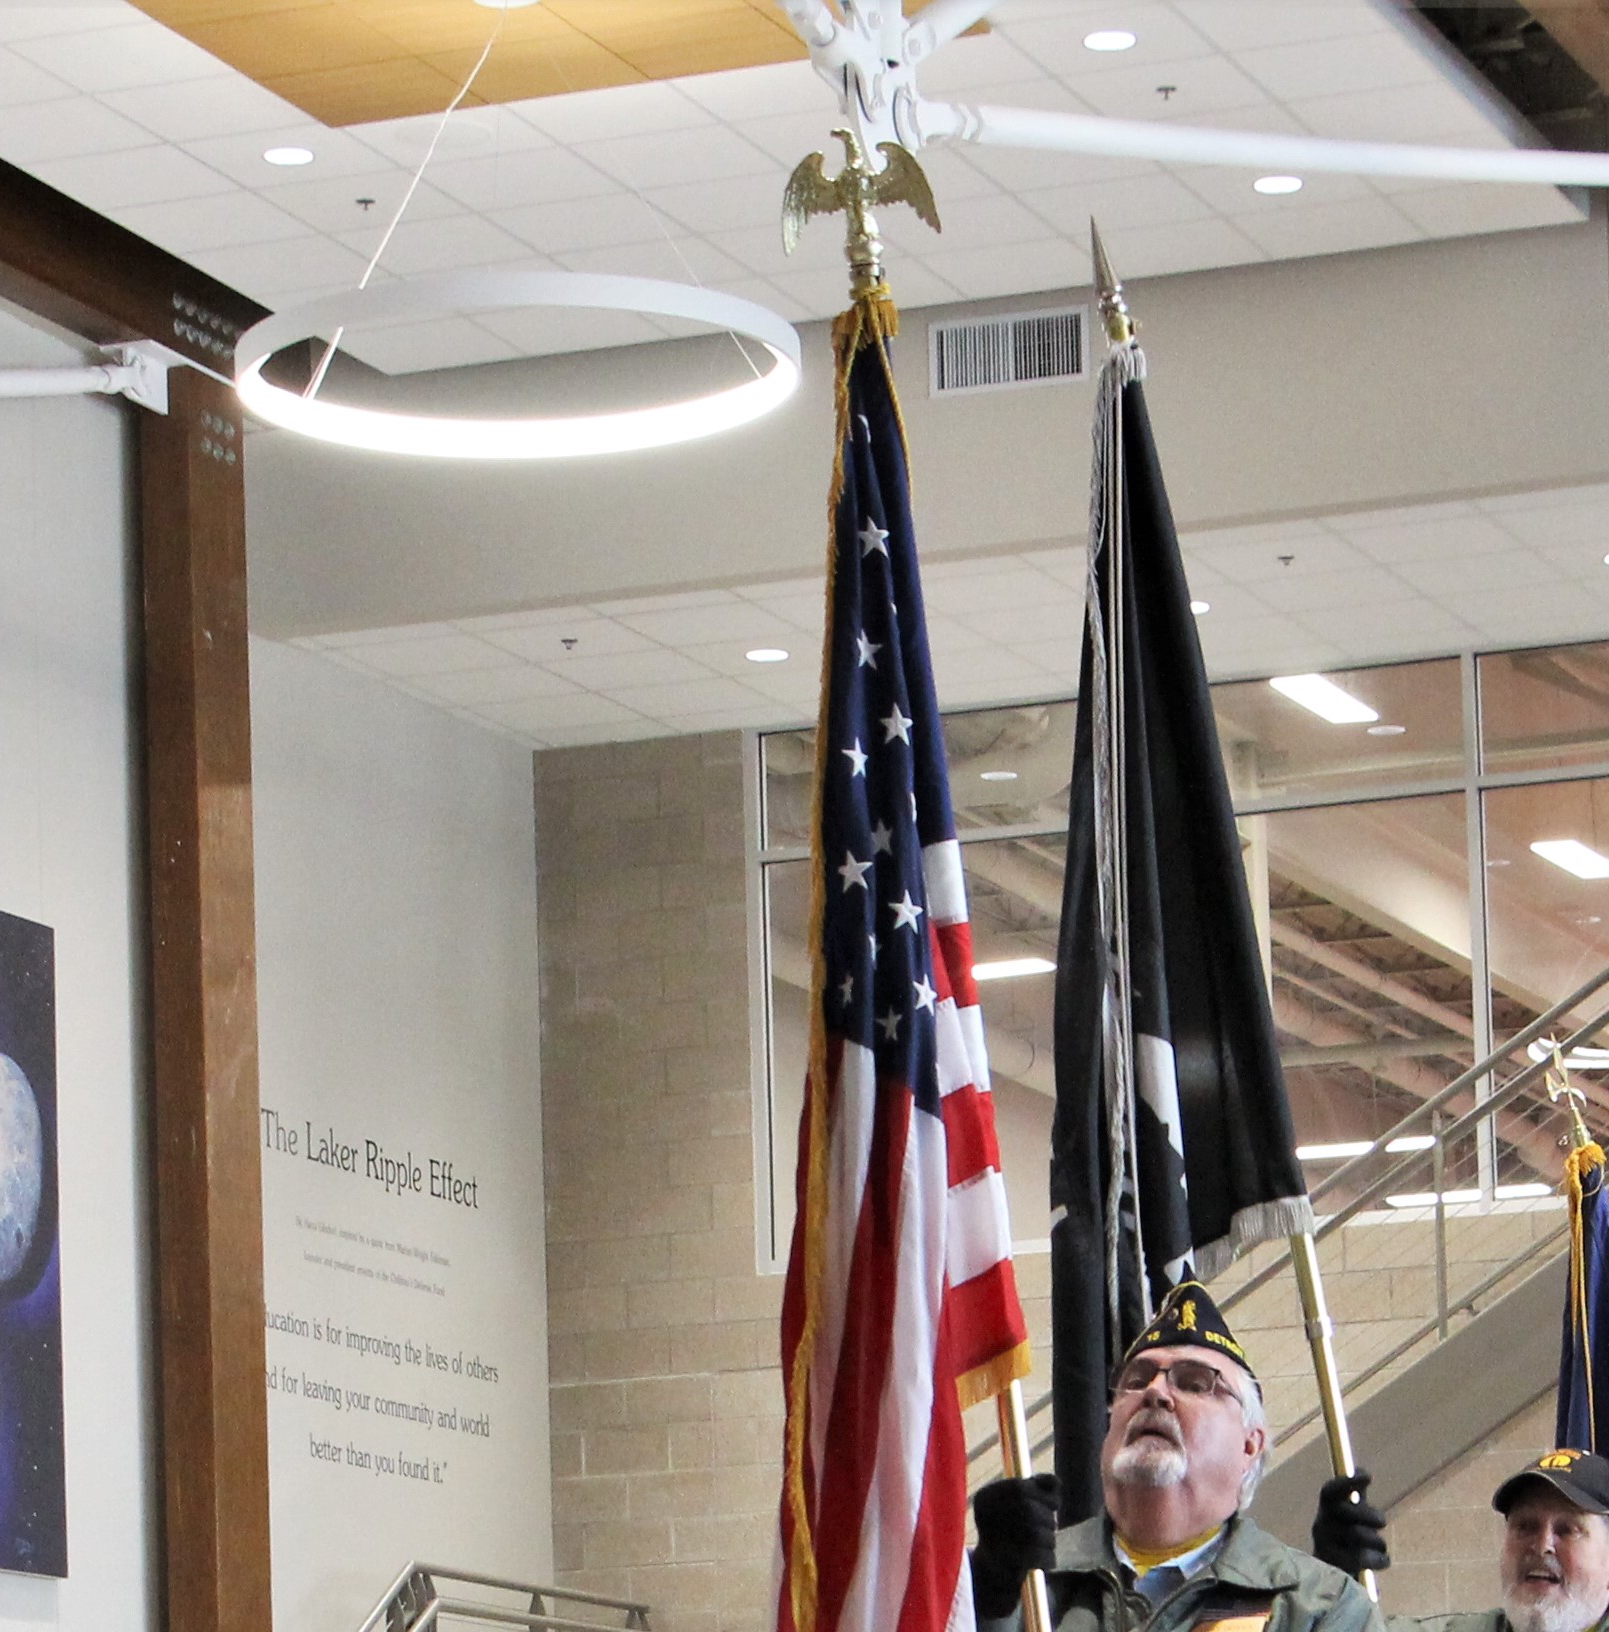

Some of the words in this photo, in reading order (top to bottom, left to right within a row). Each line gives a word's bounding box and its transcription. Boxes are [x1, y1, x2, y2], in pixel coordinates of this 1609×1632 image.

[261, 1108, 298, 1156] The
[305, 1121, 358, 1173] Laker
[365, 1139, 423, 1196] Ripple
[429, 1158, 479, 1209] Effect
[264, 1311, 309, 1338] ucation
[313, 1317, 322, 1340] is
[326, 1318, 342, 1345] for
[346, 1326, 401, 1366] improving
[404, 1339, 421, 1366] the
[425, 1343, 448, 1372] lives
[452, 1351, 462, 1374] of
[466, 1355, 499, 1383] others
[282, 1366, 298, 1394] for
[302, 1372, 342, 1410] leaving
[345, 1389, 370, 1412] your
[374, 1396, 434, 1430] community
[438, 1407, 457, 1430] and
[461, 1414, 490, 1437] world
[309, 1432, 342, 1463] better
[346, 1441, 371, 1470] than
[375, 1453, 394, 1477] you
[398, 1451, 429, 1481] found
